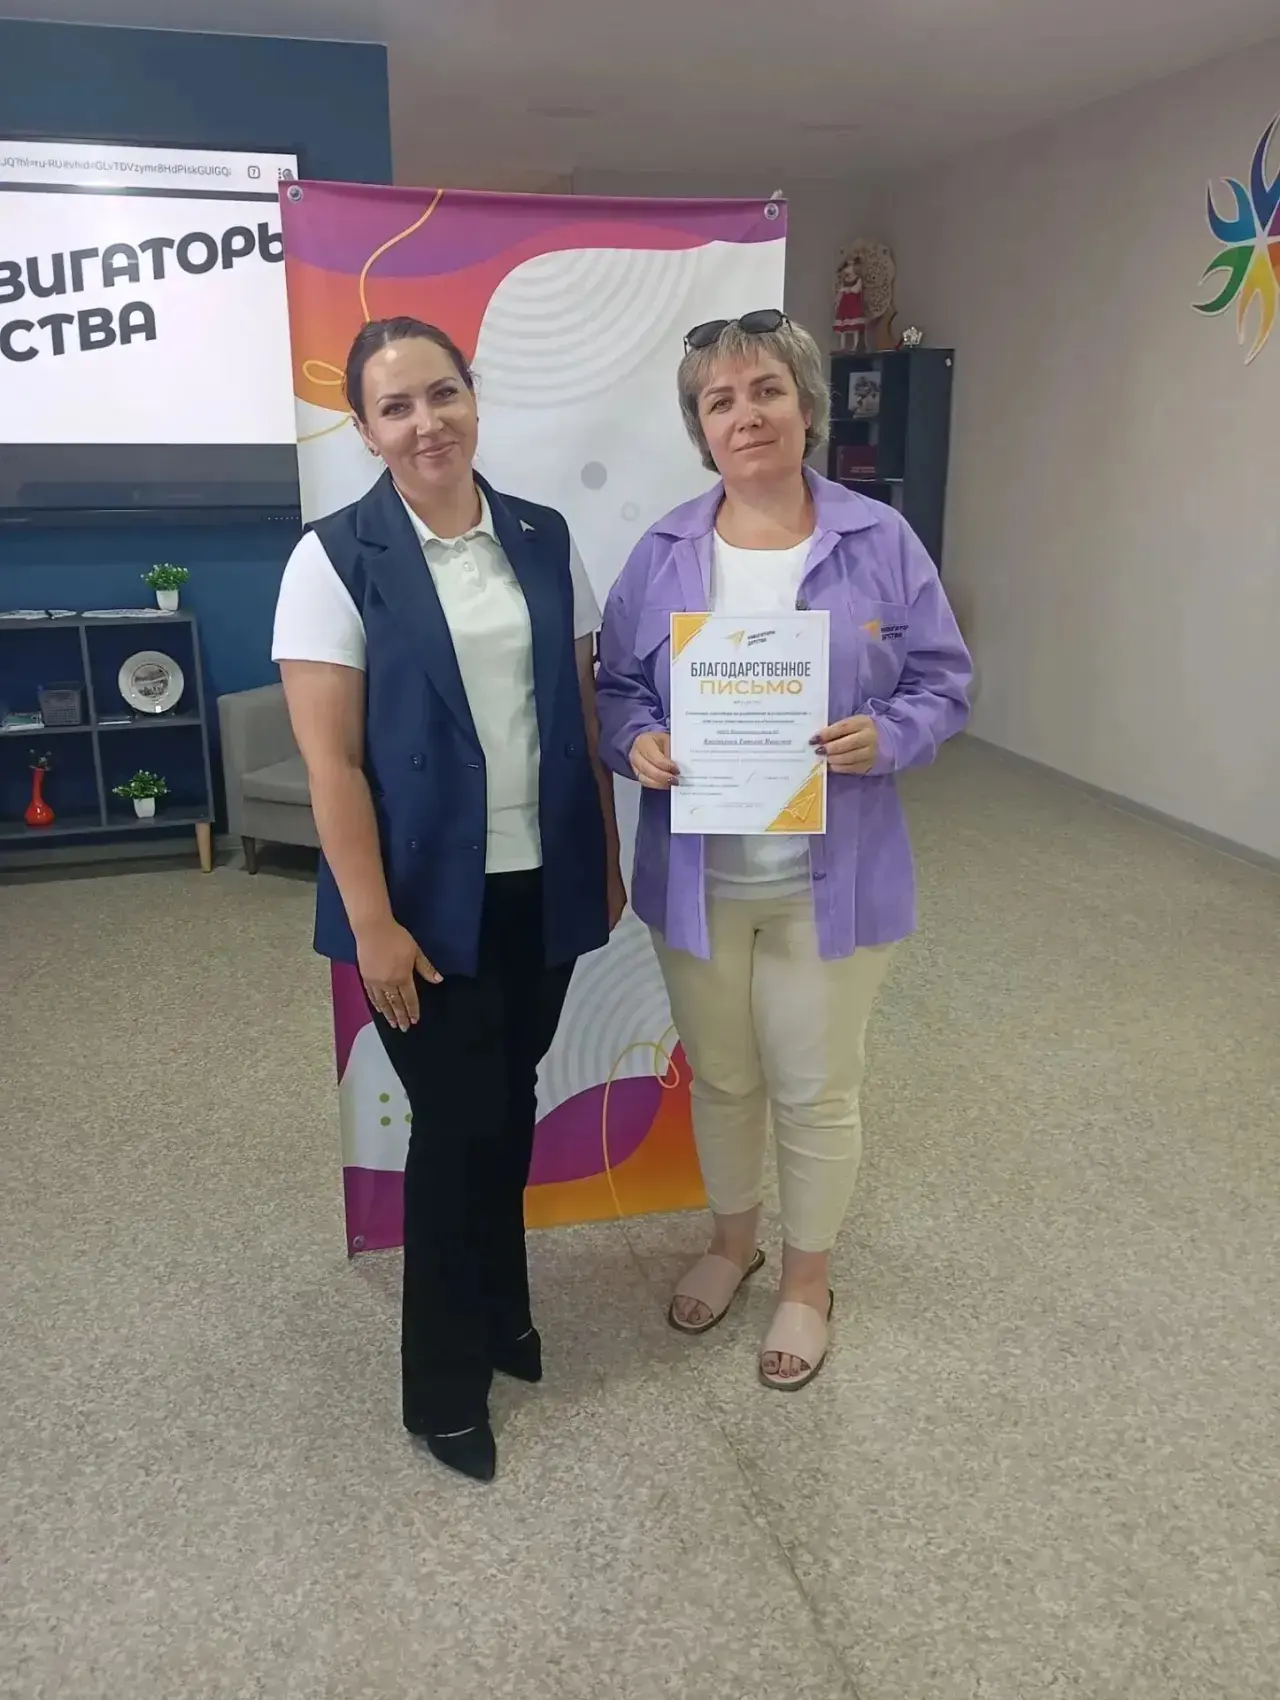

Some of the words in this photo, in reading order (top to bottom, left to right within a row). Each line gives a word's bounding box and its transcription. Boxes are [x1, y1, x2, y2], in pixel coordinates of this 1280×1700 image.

[0, 300, 157, 362] СТВА
[690, 661, 811, 678] БЛАГОДАРСТВЕННОЕ
[700, 679, 803, 694] ПИСЬМО
